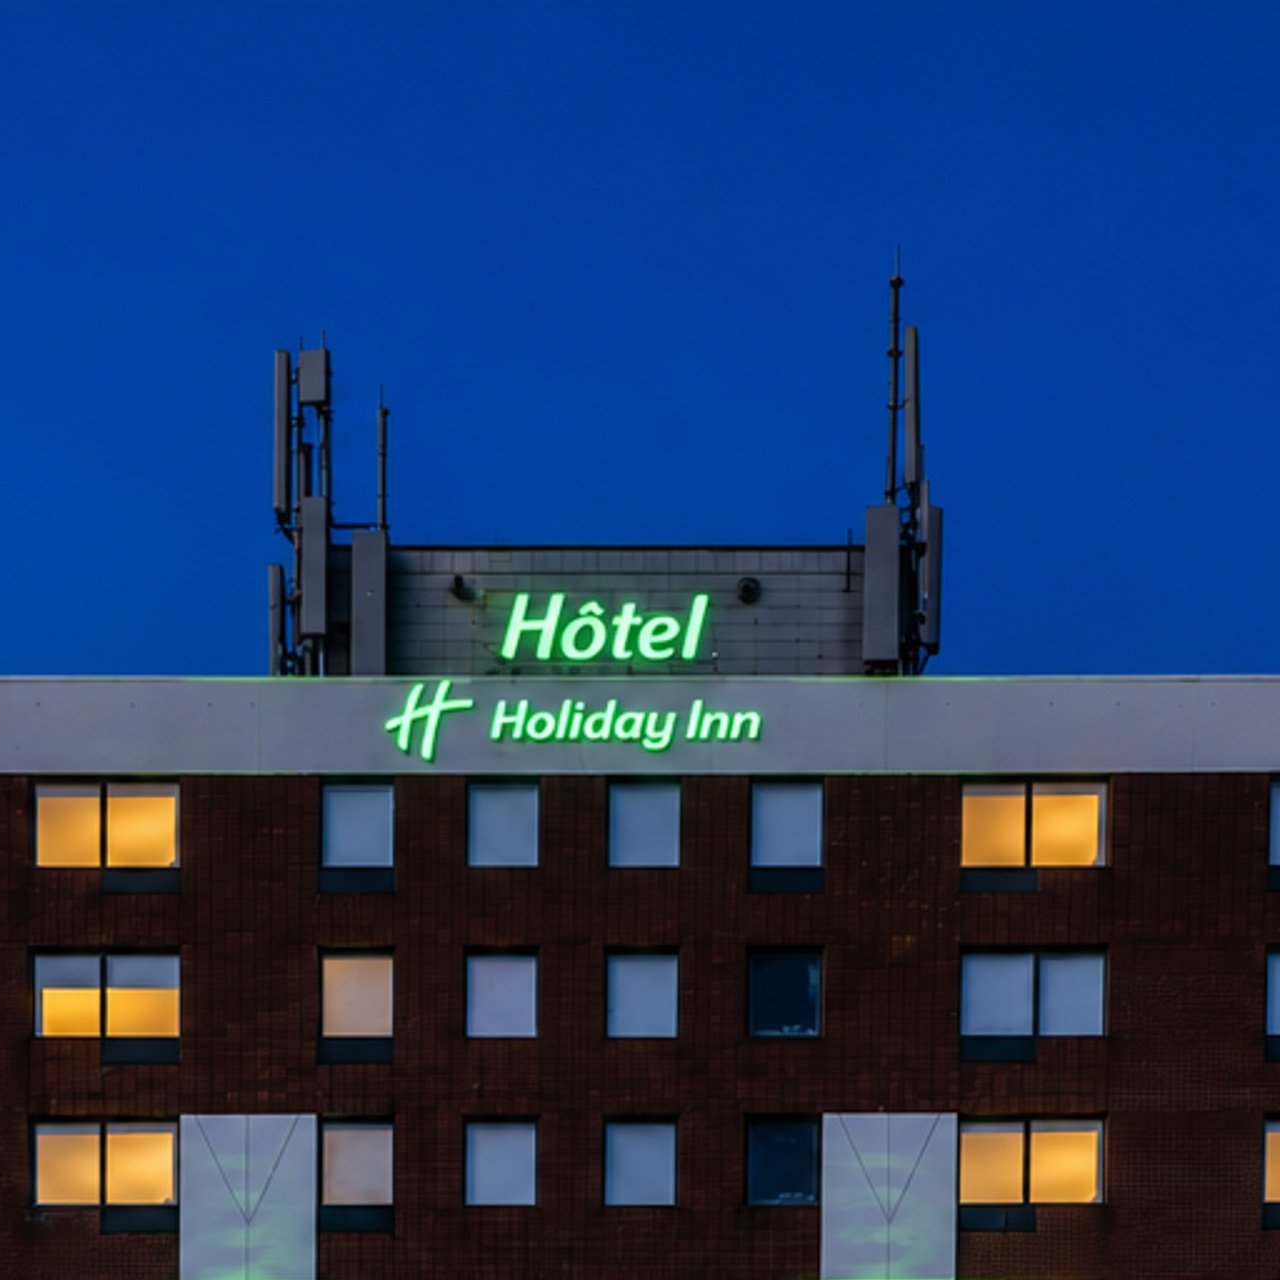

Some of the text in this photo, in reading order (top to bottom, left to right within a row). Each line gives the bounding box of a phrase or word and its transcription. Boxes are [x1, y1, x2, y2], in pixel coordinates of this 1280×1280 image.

[500, 593, 709, 660] Hôtel
[489, 699, 677, 752] Holiday
[685, 699, 762, 741] Inn
